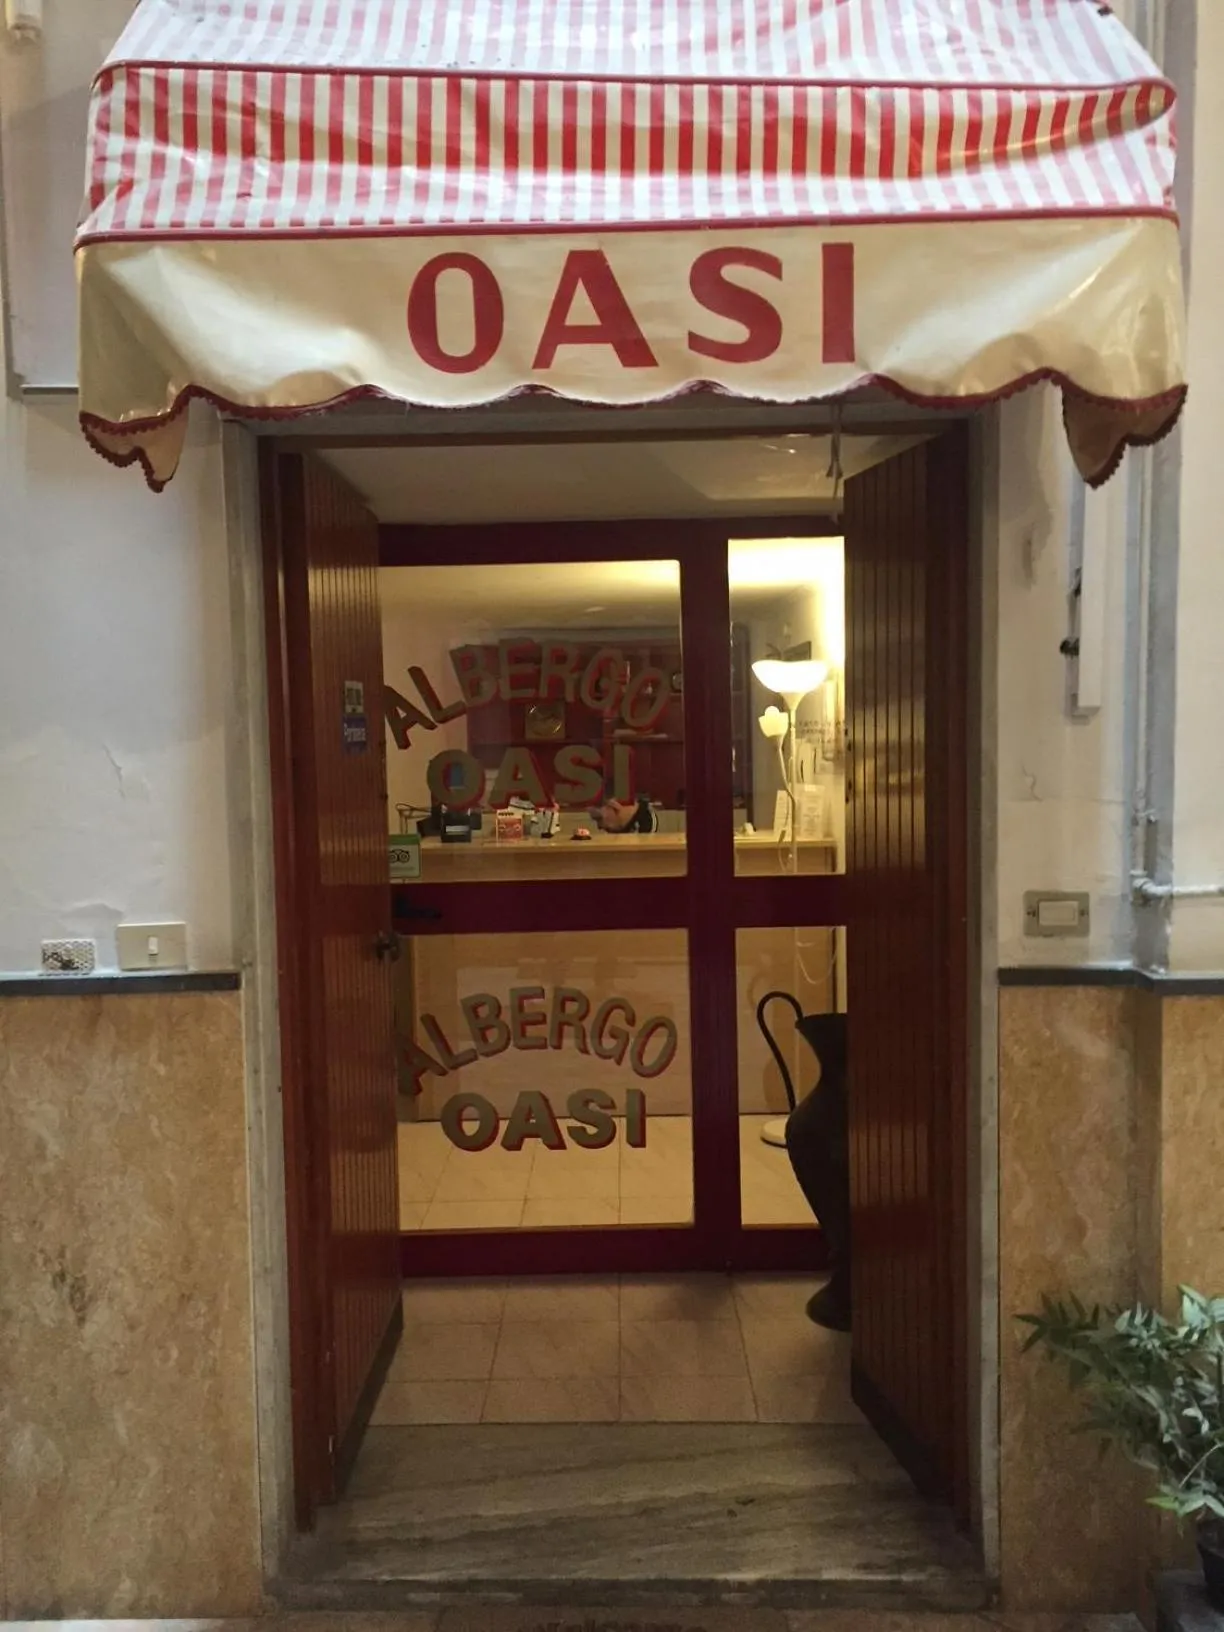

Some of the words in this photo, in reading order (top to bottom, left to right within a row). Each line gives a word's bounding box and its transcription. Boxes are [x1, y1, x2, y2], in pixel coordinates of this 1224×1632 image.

[407, 242, 855, 373] OASI
[384, 637, 671, 750] ALBERGO
[426, 744, 635, 812] OASI
[396, 986, 678, 1096] ALBERGO
[440, 1088, 647, 1152] OASI
